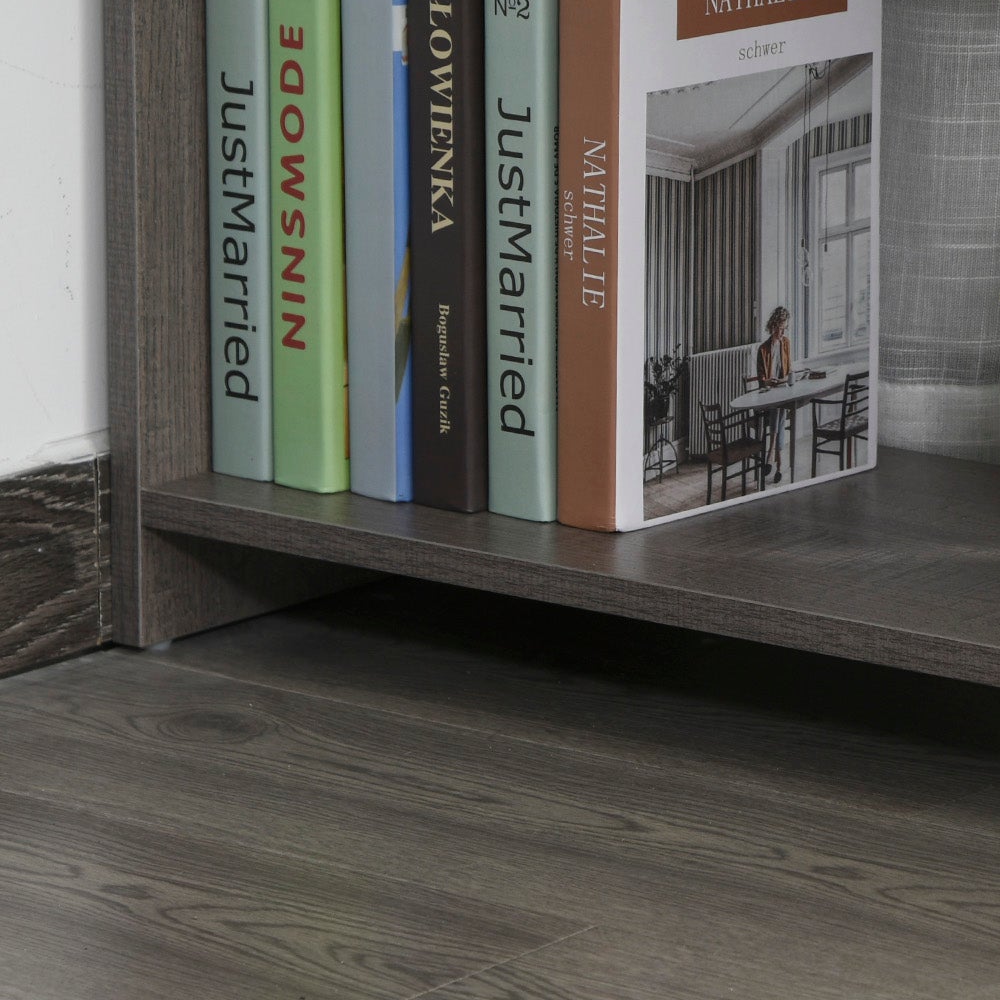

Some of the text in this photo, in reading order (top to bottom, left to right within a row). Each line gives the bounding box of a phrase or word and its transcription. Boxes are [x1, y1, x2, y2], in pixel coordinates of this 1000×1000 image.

[738, 40, 787, 61] schwer
[220, 71, 259, 402] JustMarried
[279, 24, 306, 350] NINSMODE
[497, 97, 536, 438] JustMarried
[563, 189, 575, 262] schwer
[582, 136, 607, 310] NATHALIE
[438, 385, 452, 435] Guzik
